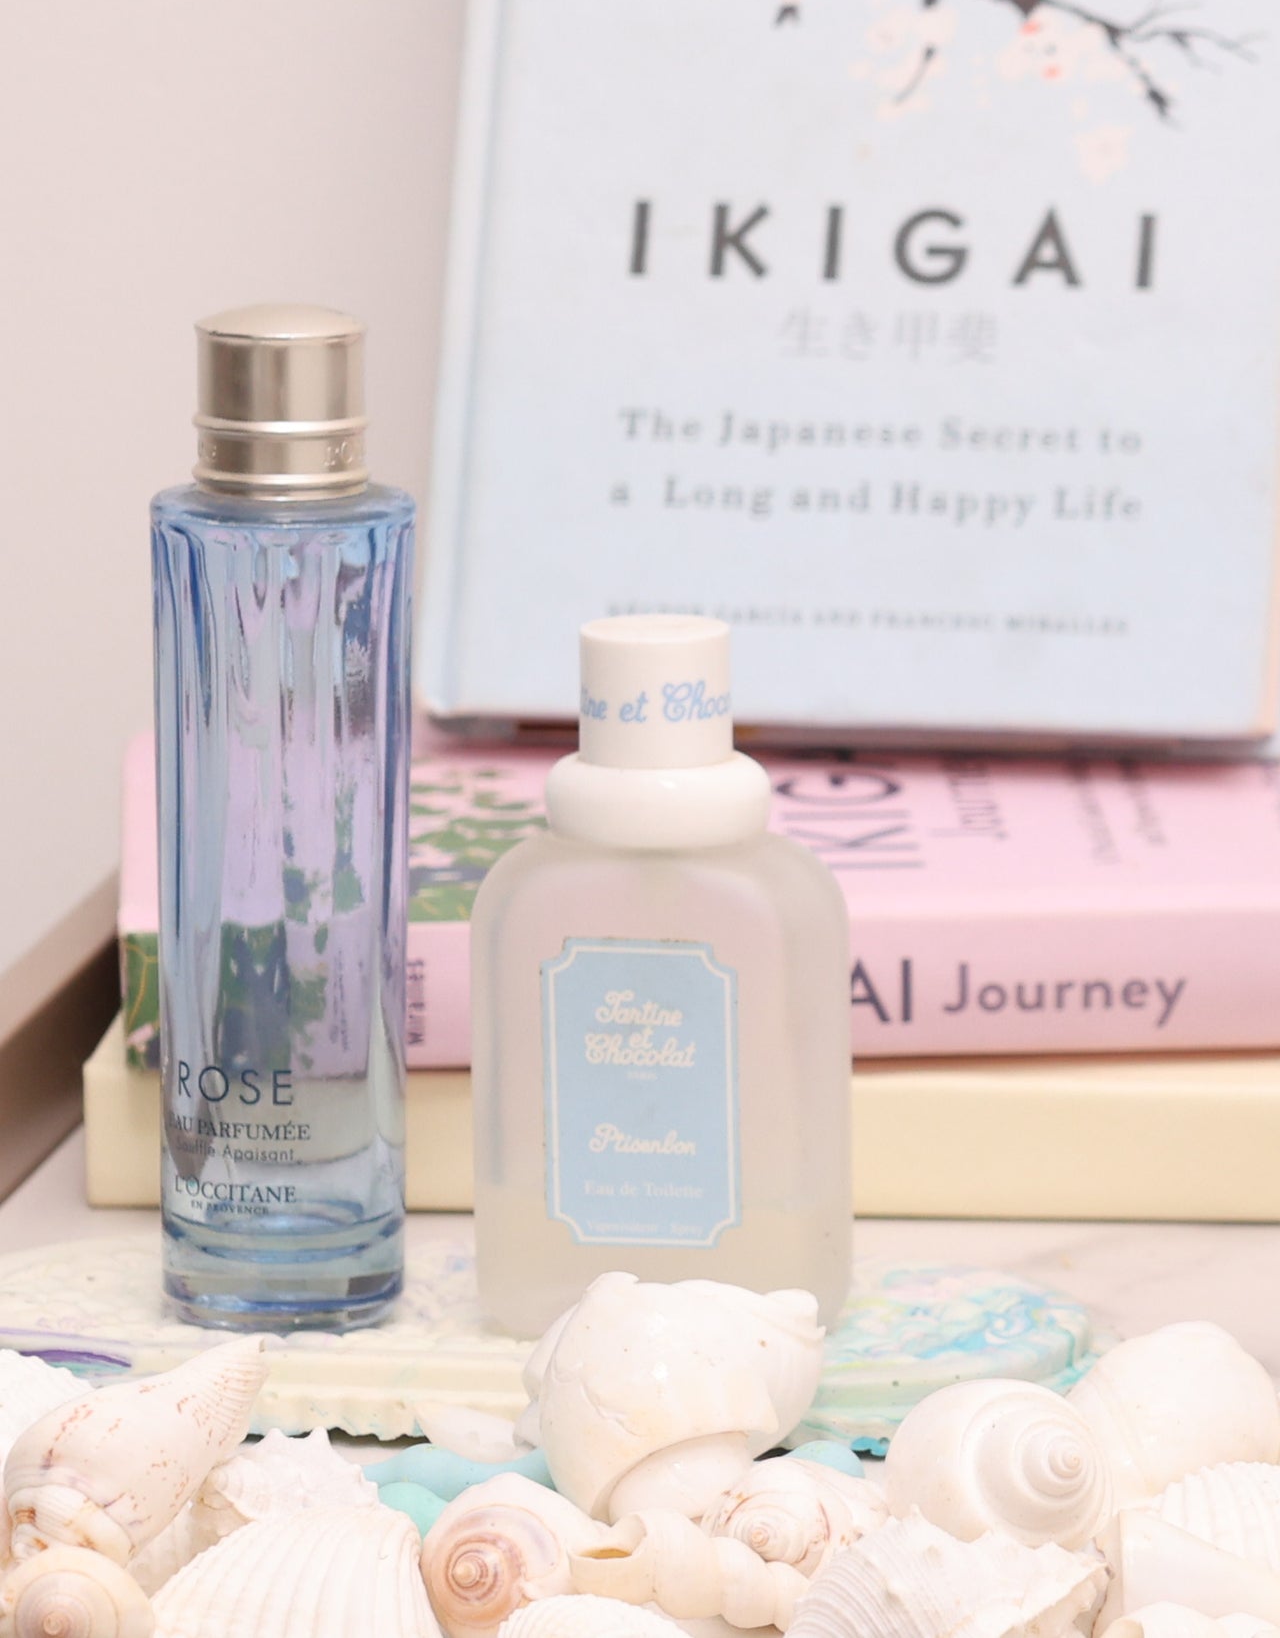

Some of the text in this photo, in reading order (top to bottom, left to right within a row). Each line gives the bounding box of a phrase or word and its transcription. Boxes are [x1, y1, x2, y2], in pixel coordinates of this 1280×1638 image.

[628, 200, 1157, 290] IKIGAI
[618, 407, 1143, 455] The Japanese Secret to
[608, 476, 1143, 527] a Long and Happy Life
[619, 691, 648, 722] et
[661, 680, 730, 722] Choc
[595, 989, 684, 1027] Tartine
[850, 958, 1188, 1027] AI Journey
[585, 1033, 696, 1067] Chocolat
[629, 1026, 654, 1049] et
[178, 1060, 293, 1106] ROSE
[198, 1120, 311, 1141] PARFUMÉE
[222, 1144, 294, 1162] Apaisant
[175, 1174, 297, 1204] L'OCCITANE
[584, 1180, 614, 1195] Eau
[619, 1181, 637, 1196] de
